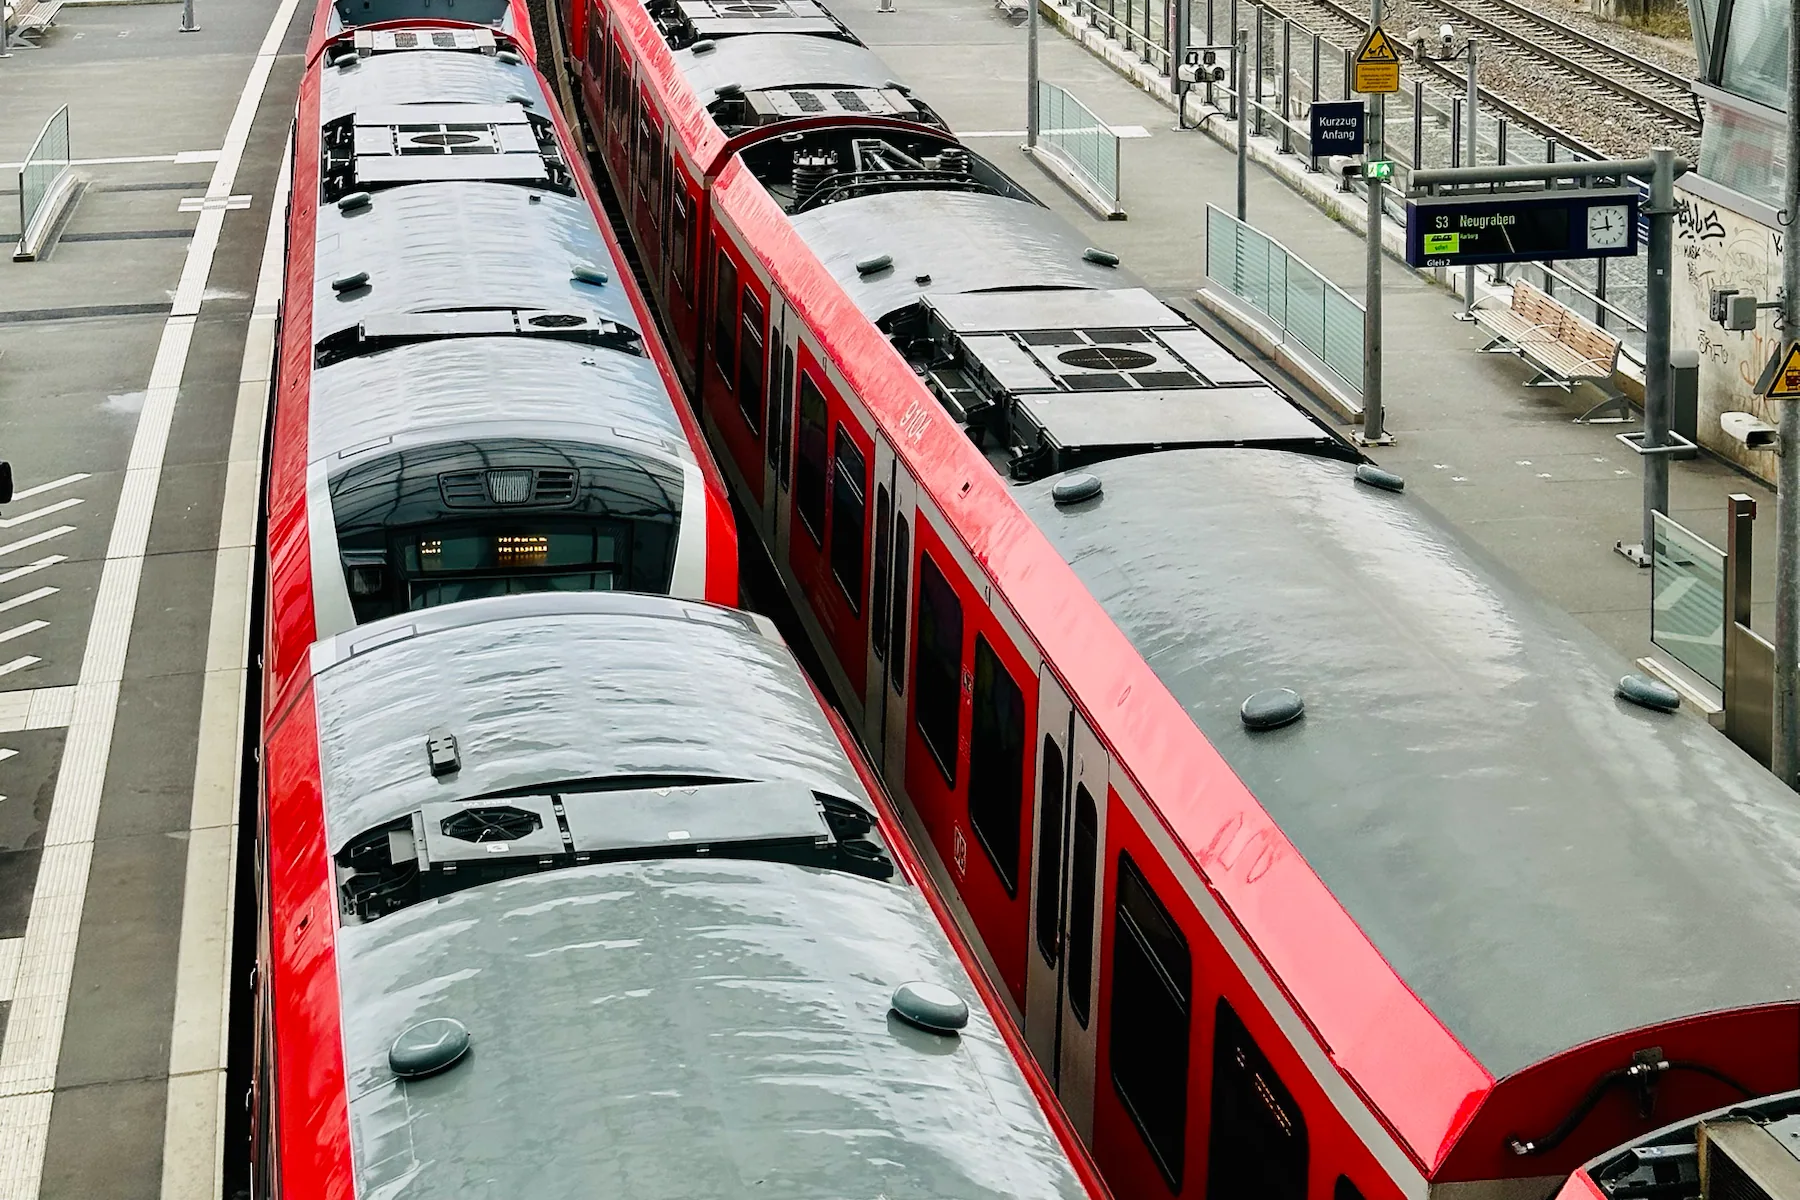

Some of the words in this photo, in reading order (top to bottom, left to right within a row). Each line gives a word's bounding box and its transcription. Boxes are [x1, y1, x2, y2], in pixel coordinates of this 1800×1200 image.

[1319, 116, 1357, 128] Kurzzug
[1322, 129, 1355, 141] Anfang
[1435, 215, 1449, 229] S3
[1459, 212, 1516, 230] Neugraben
[1426, 259, 1445, 267] Gleis
[1445, 258, 1451, 266] 2
[900, 400, 933, 445] 9104
